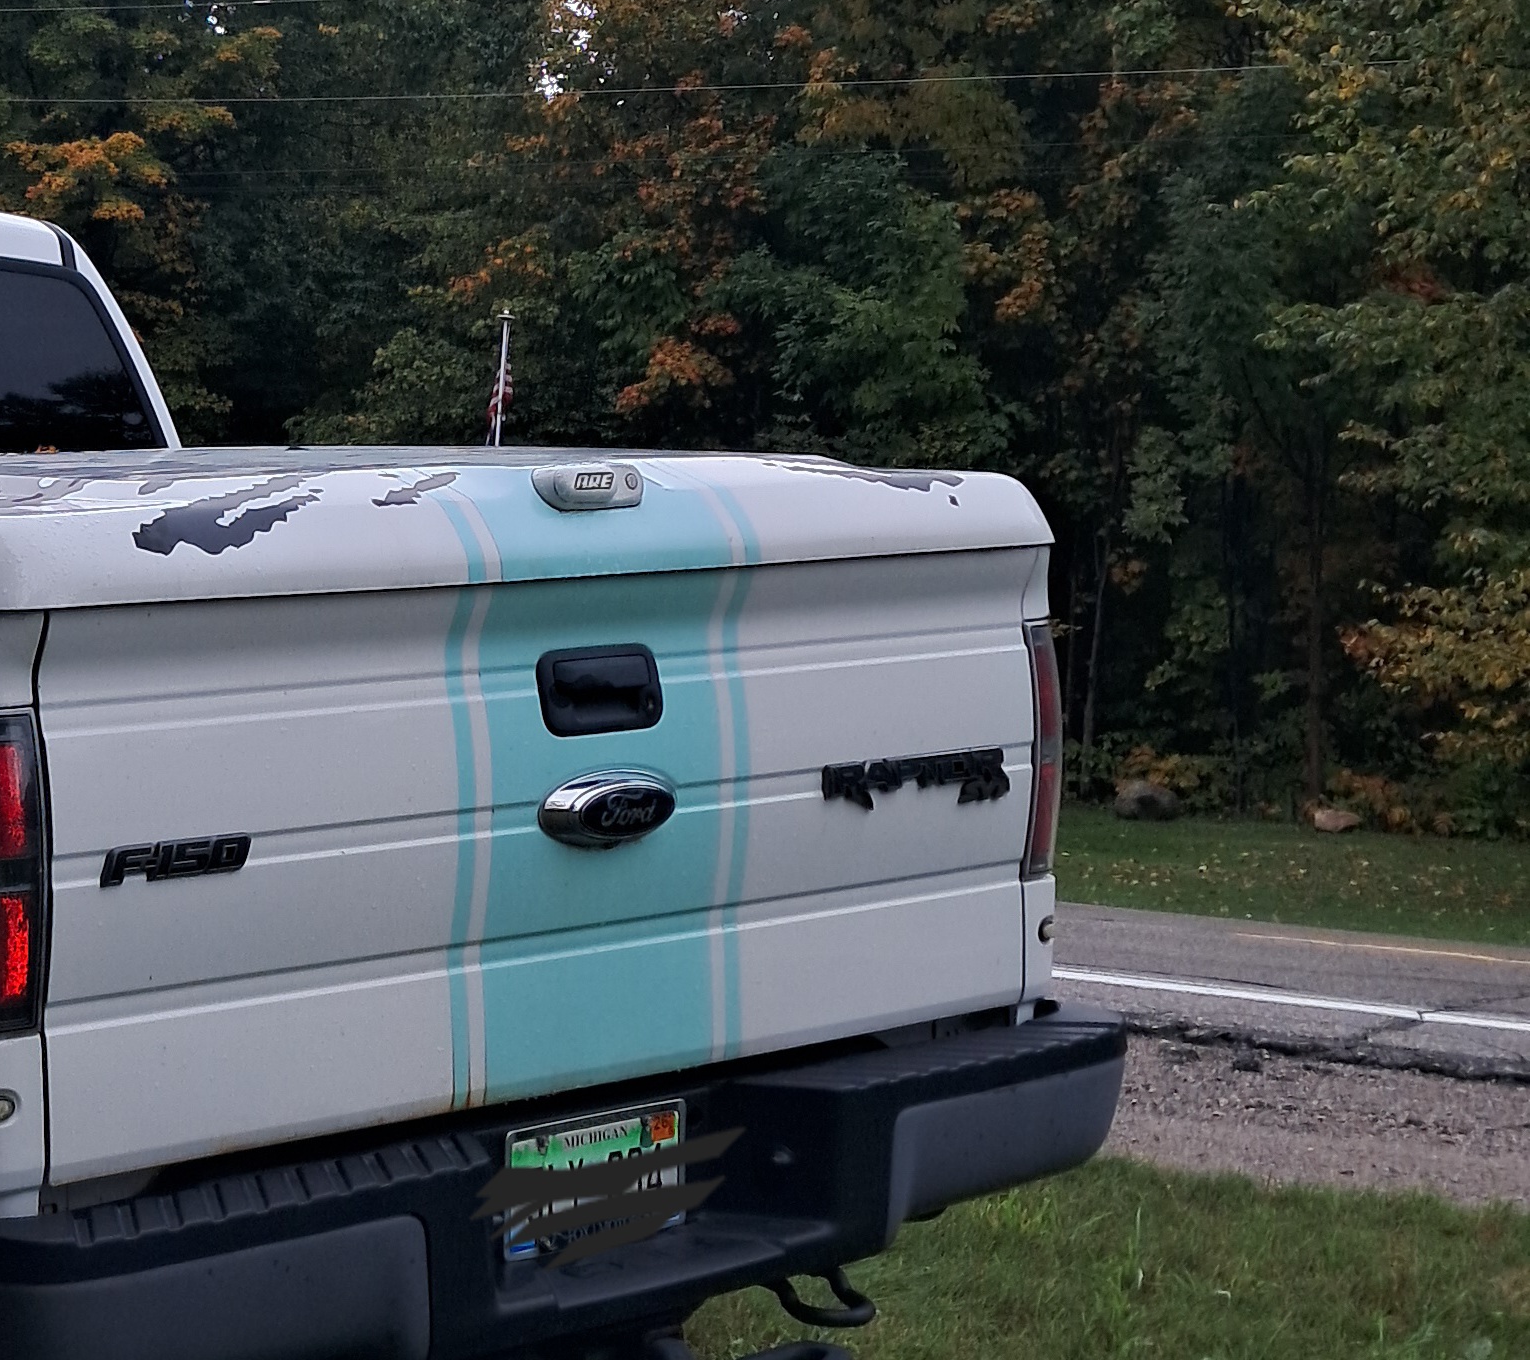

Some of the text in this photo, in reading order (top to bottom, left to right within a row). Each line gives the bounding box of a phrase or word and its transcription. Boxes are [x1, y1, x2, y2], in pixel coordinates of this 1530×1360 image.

[575, 472, 614, 490] ARE
[601, 789, 658, 827] Ford
[99, 832, 252, 888] F-150
[564, 1127, 629, 1148] MICHIGAN
